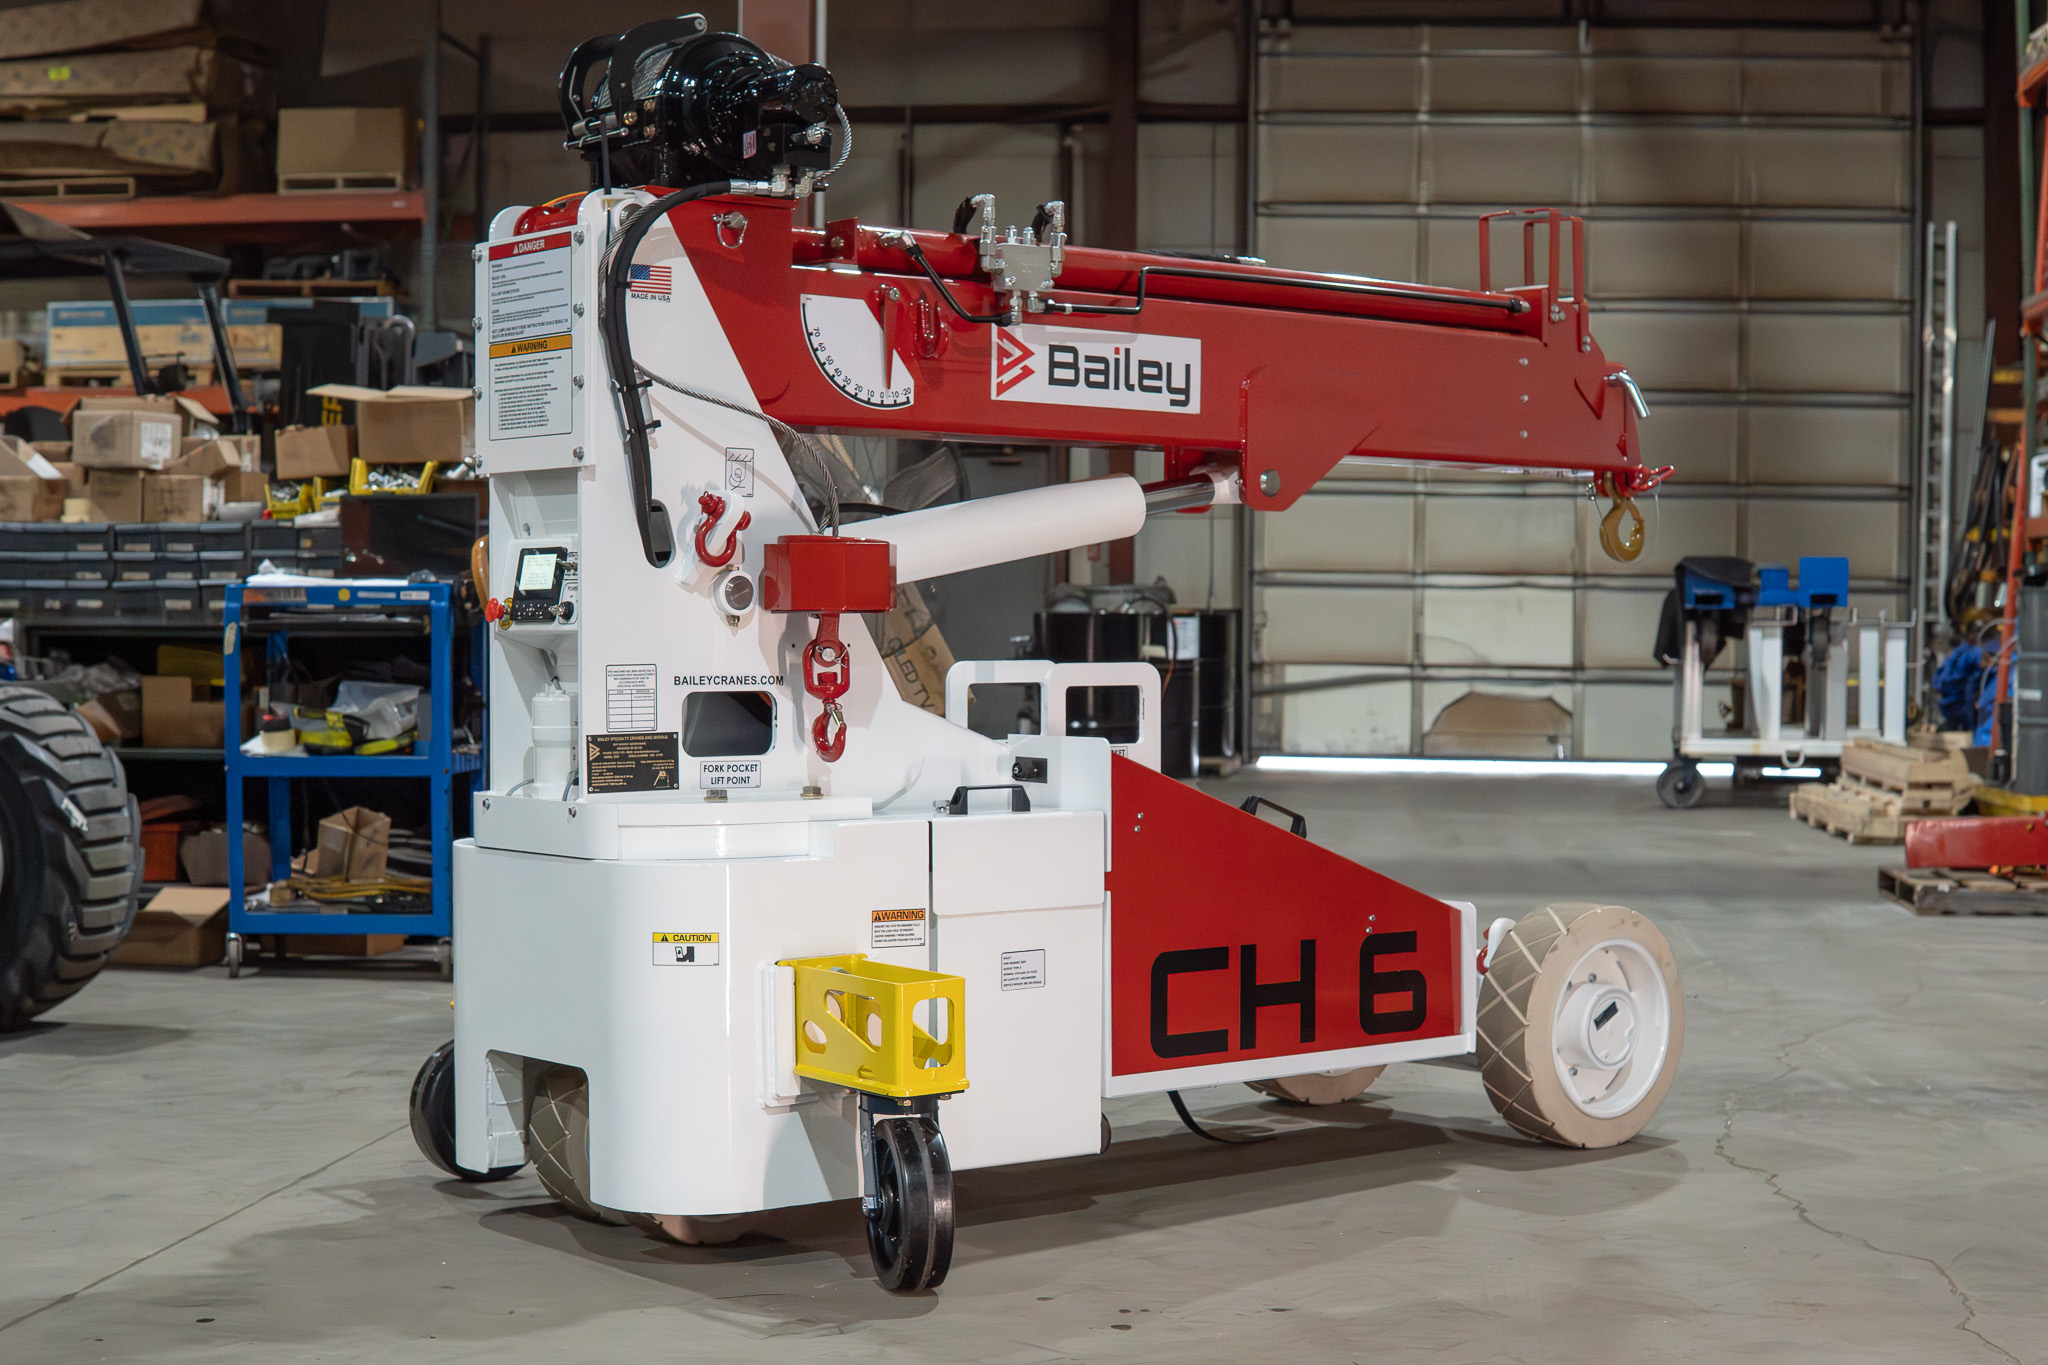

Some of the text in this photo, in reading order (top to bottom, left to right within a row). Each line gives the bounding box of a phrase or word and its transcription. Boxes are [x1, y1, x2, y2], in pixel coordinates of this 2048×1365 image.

[518, 239, 545, 253] DANGER
[631, 292, 649, 300] MADE
[517, 340, 548, 352] WARNING
[813, 327, 821, 337] 70
[818, 342, 826, 352] 60
[825, 355, 834, 365] 50
[834, 367, 842, 377] 40
[842, 376, 852, 385] 30
[854, 384, 863, 392] 20
[867, 389, 875, 397] 10
[901, 387, 912, 396] -20
[1048, 343, 1191, 407] Bailey
[673, 675, 784, 686] BAILEYCRANES.COM
[914, 683, 935, 708] TV
[703, 763, 758, 773] FORK POCKET
[711, 776, 751, 785] LIFT POINT
[881, 910, 924, 920] WARNING
[673, 934, 712, 942] CAUTION
[1151, 931, 1427, 1058] CH 6
